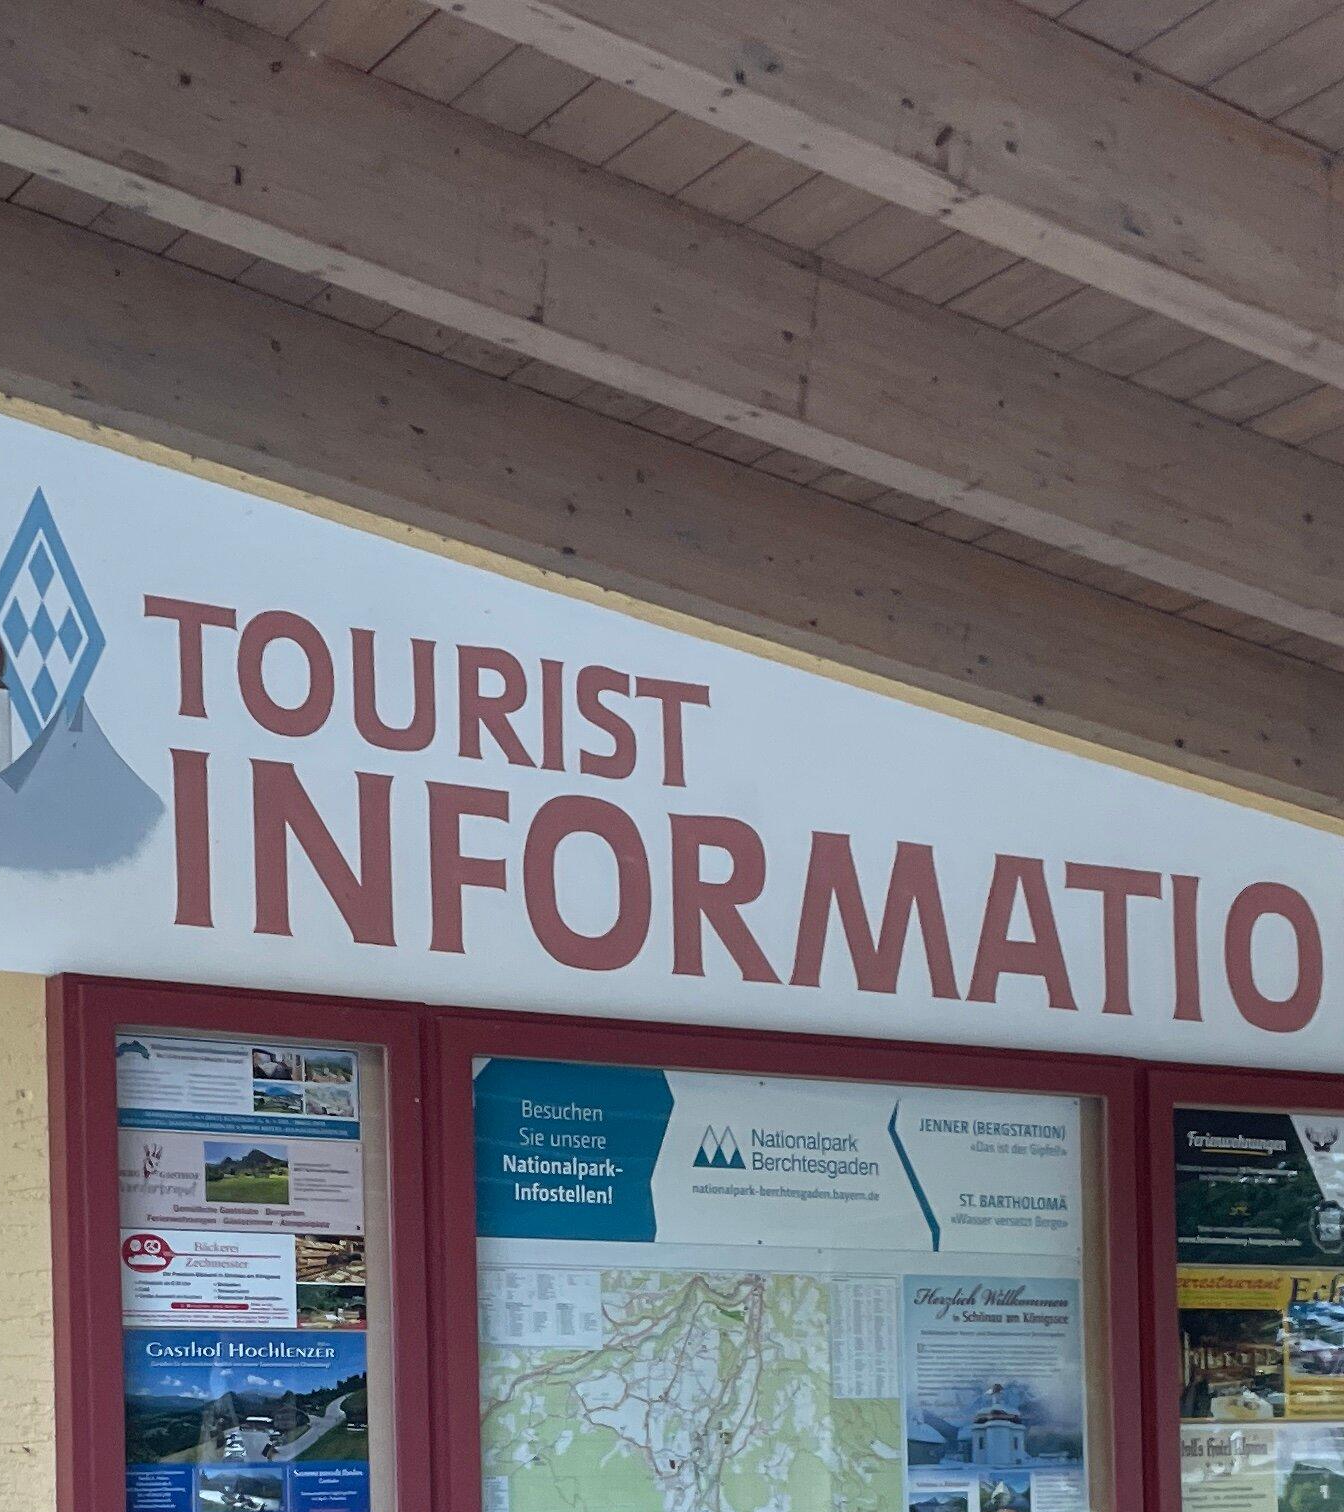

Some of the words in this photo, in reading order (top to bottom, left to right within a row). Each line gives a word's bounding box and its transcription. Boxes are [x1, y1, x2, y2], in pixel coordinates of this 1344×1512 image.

[144, 594, 710, 787] TOURIST
[522, 1100, 603, 1122] Besuchen
[519, 1127, 544, 1147] Sie
[550, 1133, 607, 1150] unsere
[919, 1118, 969, 1135] JENNER
[972, 1121, 1066, 1141] (BERGSTATION)
[751, 1129, 859, 1155] Nationalpark
[503, 1154, 624, 1180] Nationalpark-
[752, 1152, 880, 1179] Berchtesgaden
[515, 1182, 613, 1205] Infostellen!
[959, 1193, 977, 1207] ST.
[979, 1194, 1069, 1211] BARTHOLOMÄ
